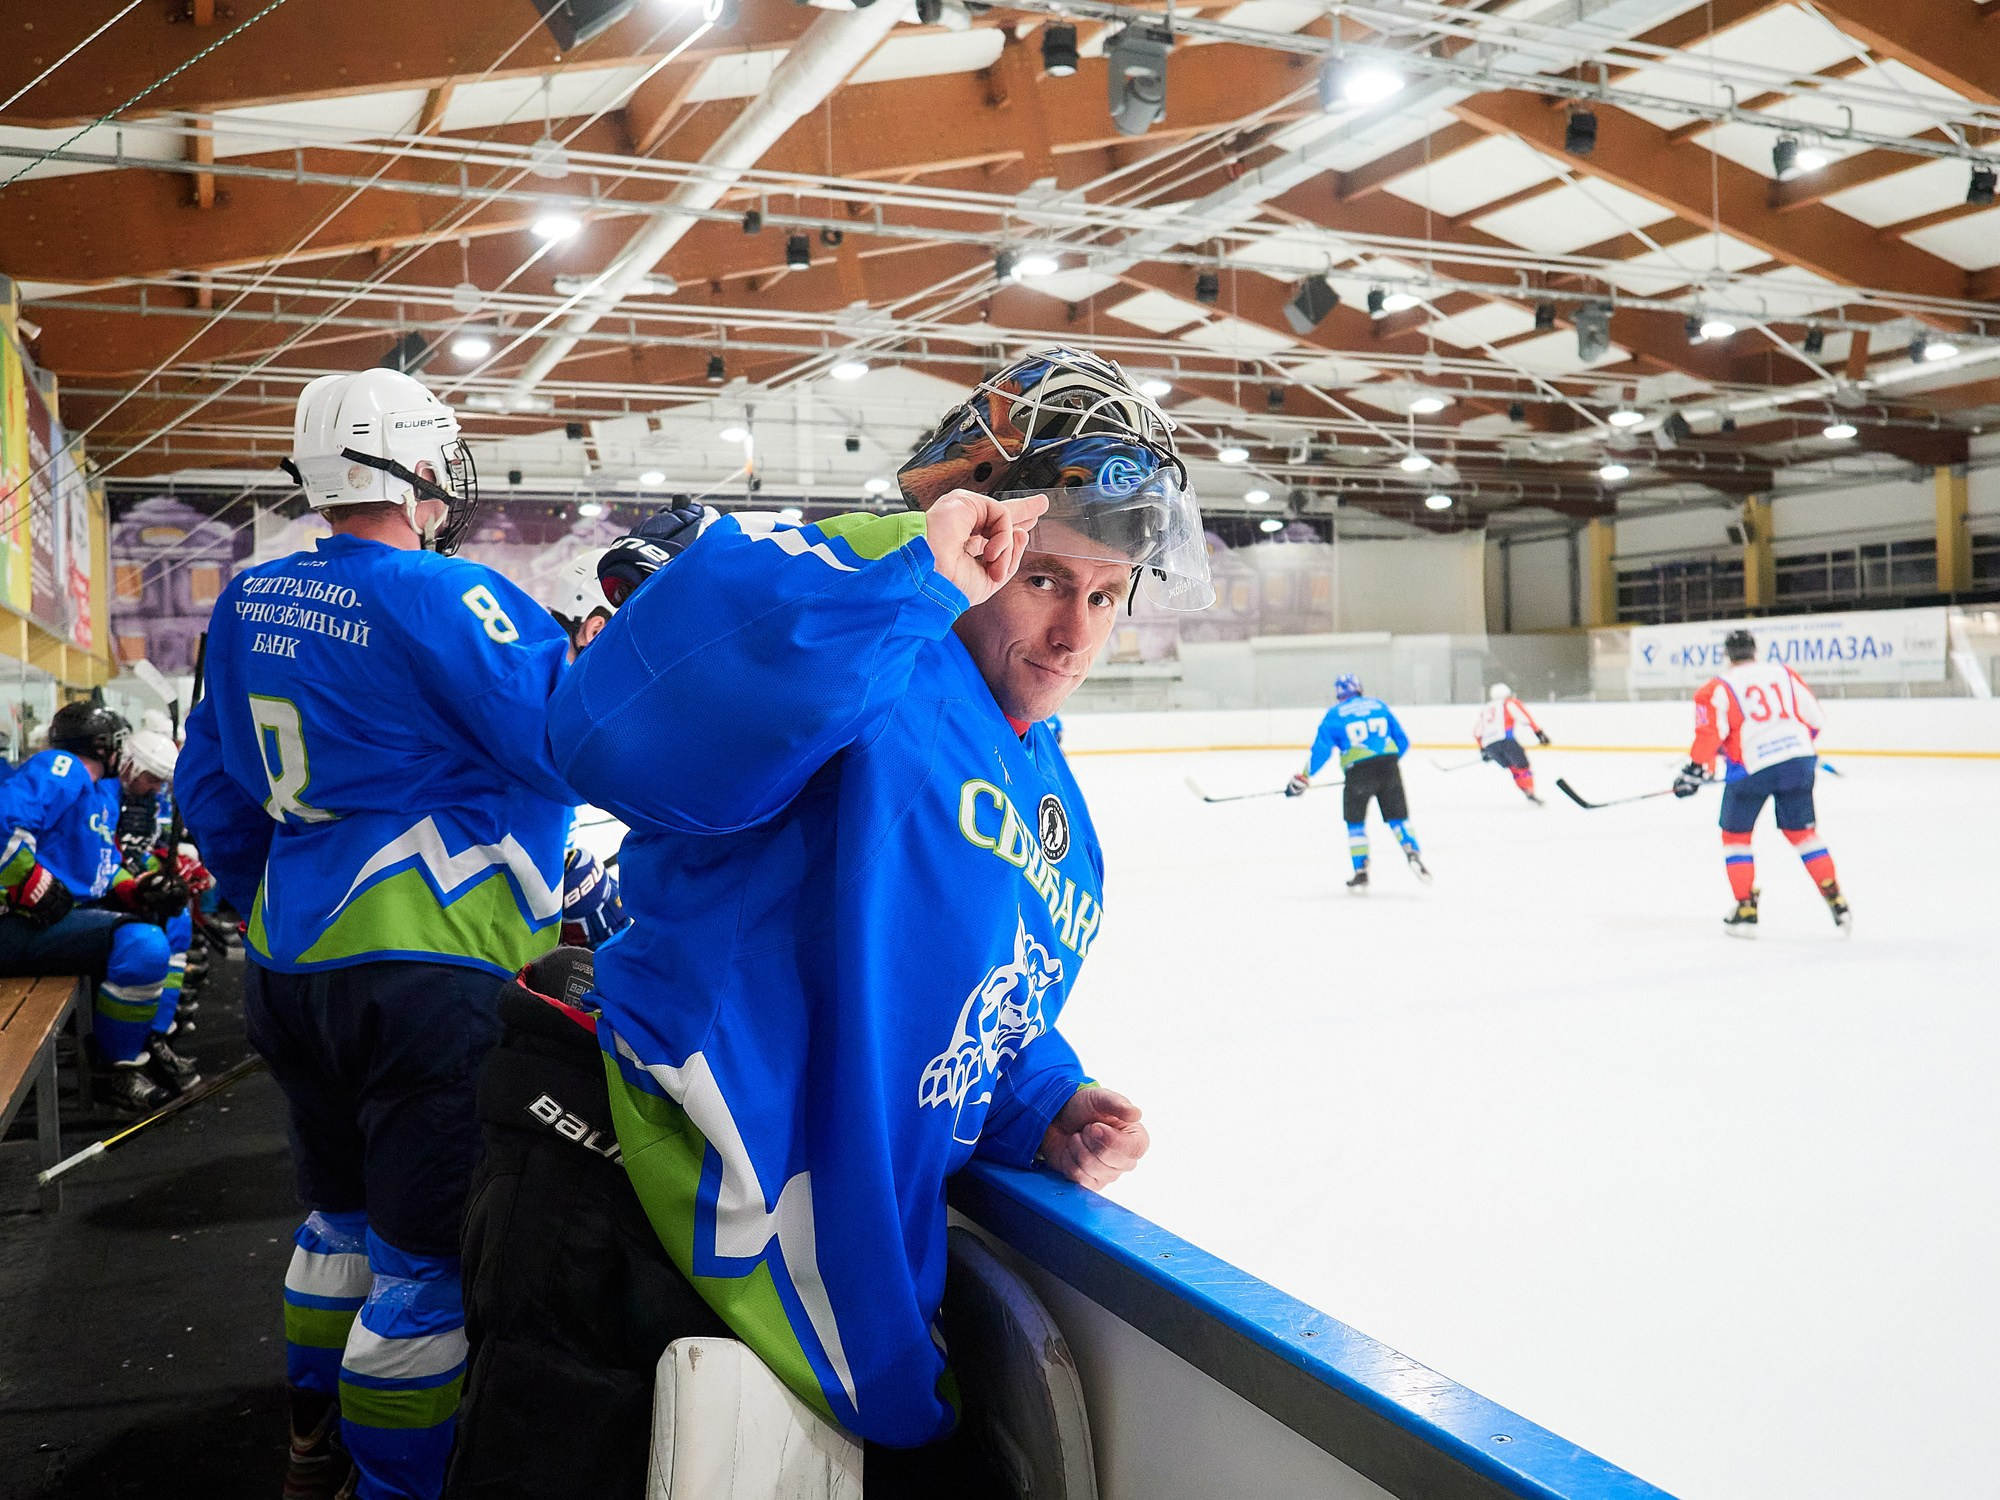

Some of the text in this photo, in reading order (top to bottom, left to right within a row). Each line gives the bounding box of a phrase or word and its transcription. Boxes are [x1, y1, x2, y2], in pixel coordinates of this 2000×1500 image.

[395, 420, 433, 429] BAUER
[1097, 455, 1144, 498] G
[235, 601, 371, 647] ЧРНОЗЁМНЫЙ
[462, 584, 519, 643] 8
[251, 633, 301, 659] БАНК
[1767, 635, 1893, 664] АЛМАЗА»
[1745, 682, 1790, 722] 31
[526, 1094, 624, 1167] BAU
